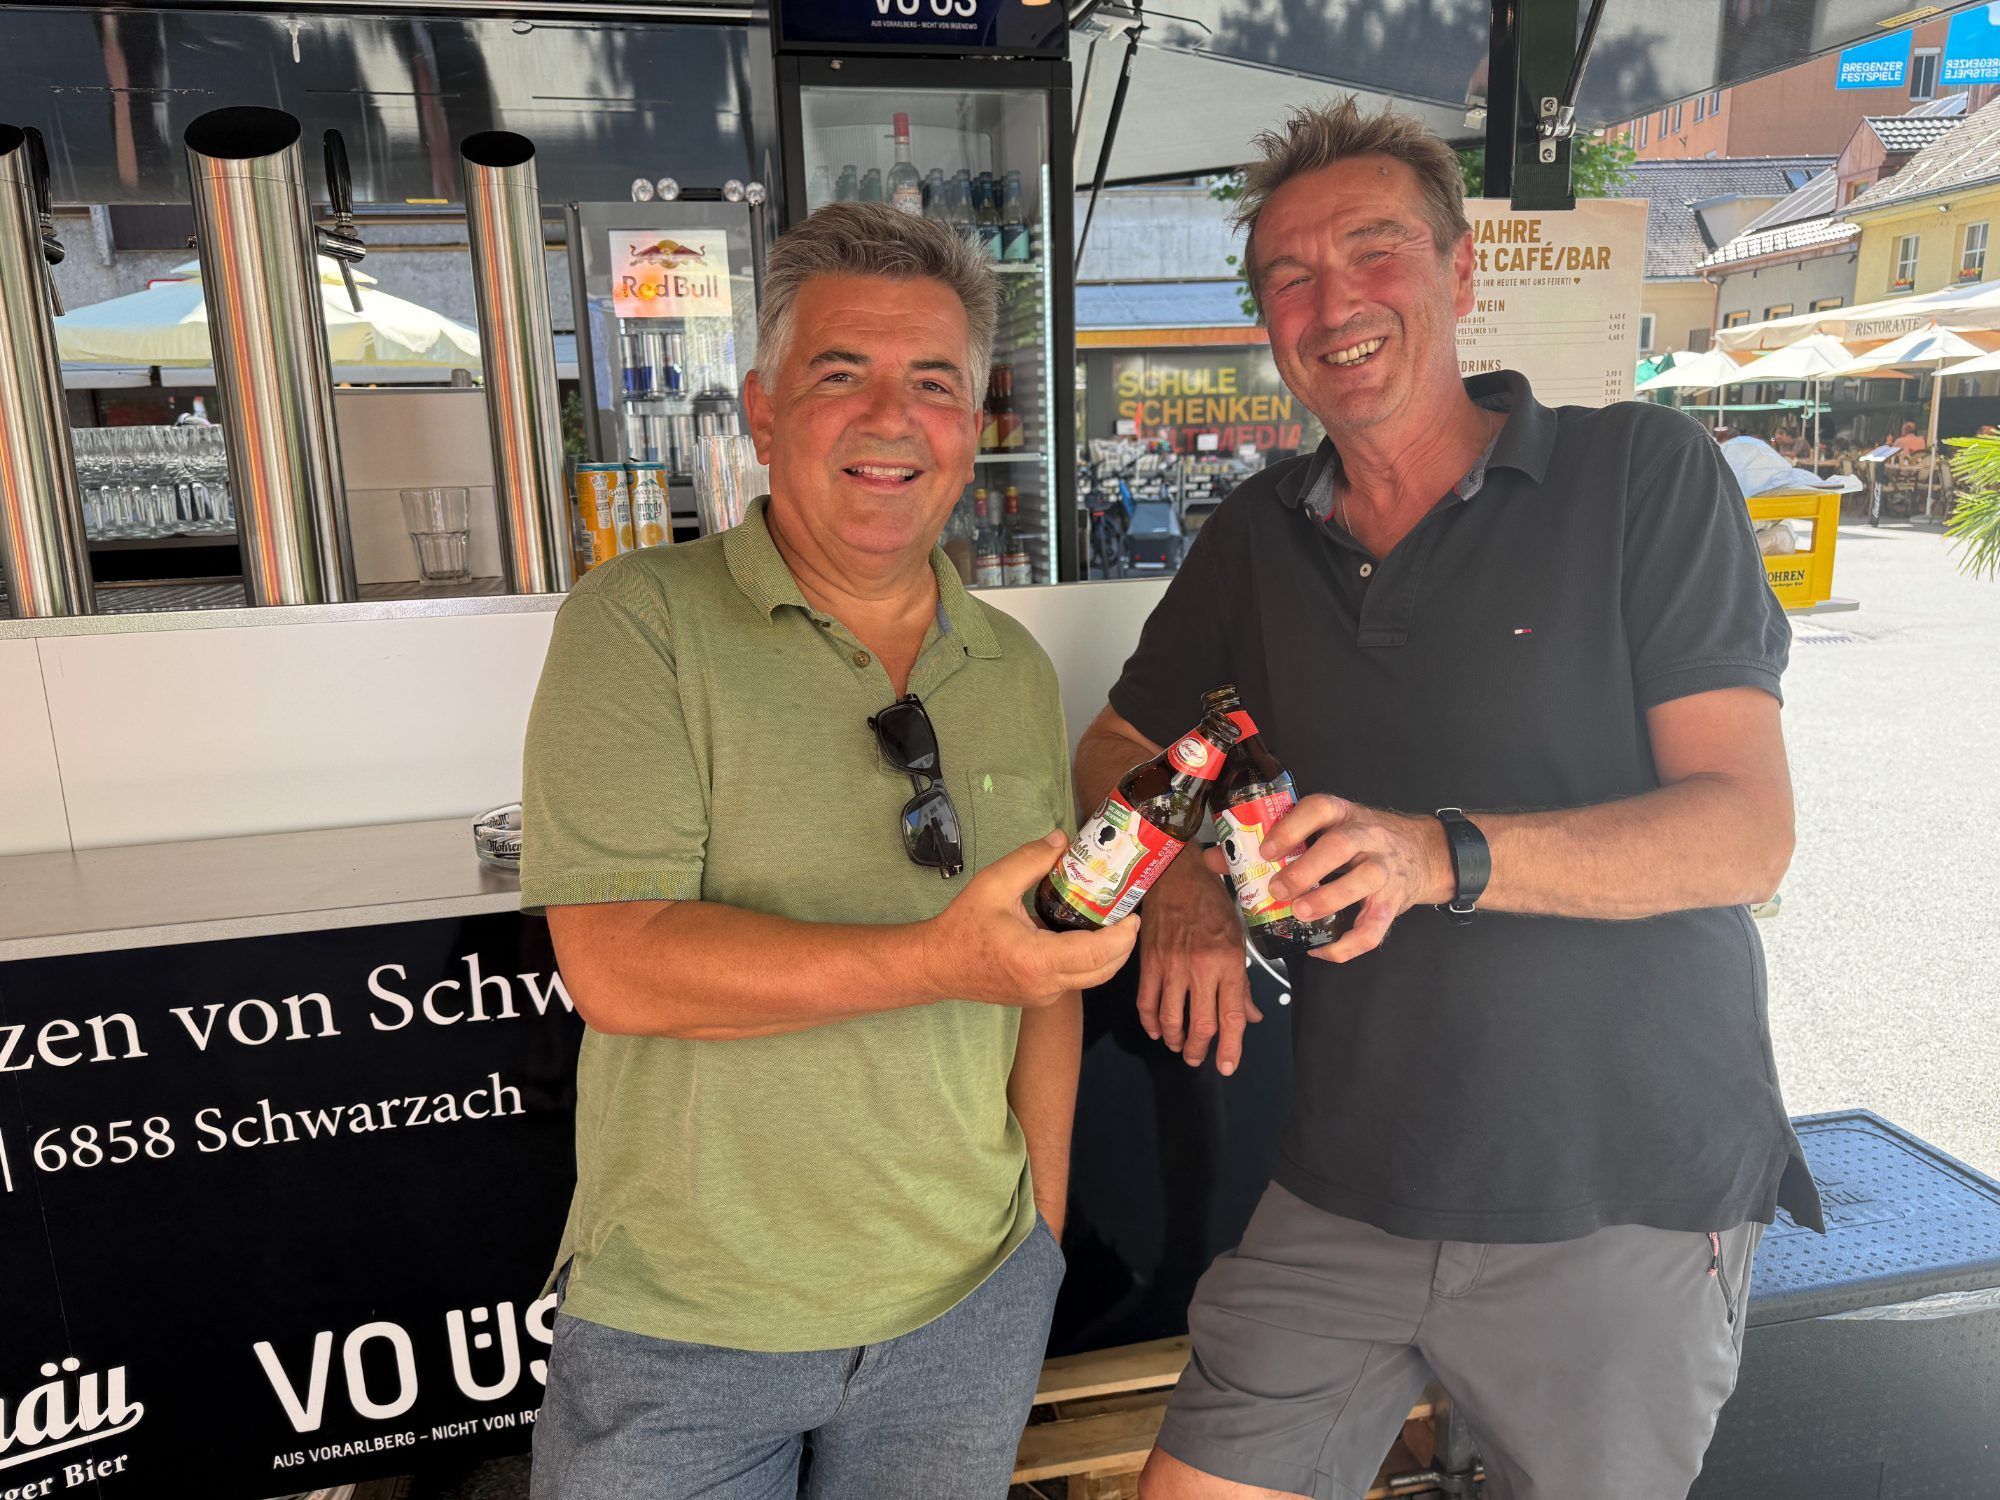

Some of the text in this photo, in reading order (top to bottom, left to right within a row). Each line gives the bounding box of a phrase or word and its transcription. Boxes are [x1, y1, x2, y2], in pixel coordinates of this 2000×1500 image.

[1840, 71, 1902, 83] FESTSPIELE
[1842, 61, 1903, 73] BREGENZER
[1473, 219, 1542, 243] JAHRE
[1494, 241, 1612, 273] CAFÉ/BAR
[622, 274, 719, 298] Red Bull
[1483, 279, 1495, 287] IHR
[1497, 278, 1518, 287] HEUTE
[1520, 278, 1531, 286] MIT
[1533, 277, 1546, 286] UNS
[1477, 299, 1505, 312] WEIN
[1855, 317, 1921, 336] RISTORANTE
[1118, 367, 1238, 397] SCHULE
[1118, 396, 1293, 426] SCHENKEN
[0, 952, 575, 1072] zen von Schw
[33, 1071, 527, 1172] 6858 Schwarzach
[252, 1321, 419, 1433] VO
[273, 1451, 305, 1470] AUS
[308, 1431, 416, 1463] VORARLBERG
[432, 1419, 479, 1441] NICHT
[482, 1410, 516, 1431] VON
[62, 1454, 128, 1488] Bier
